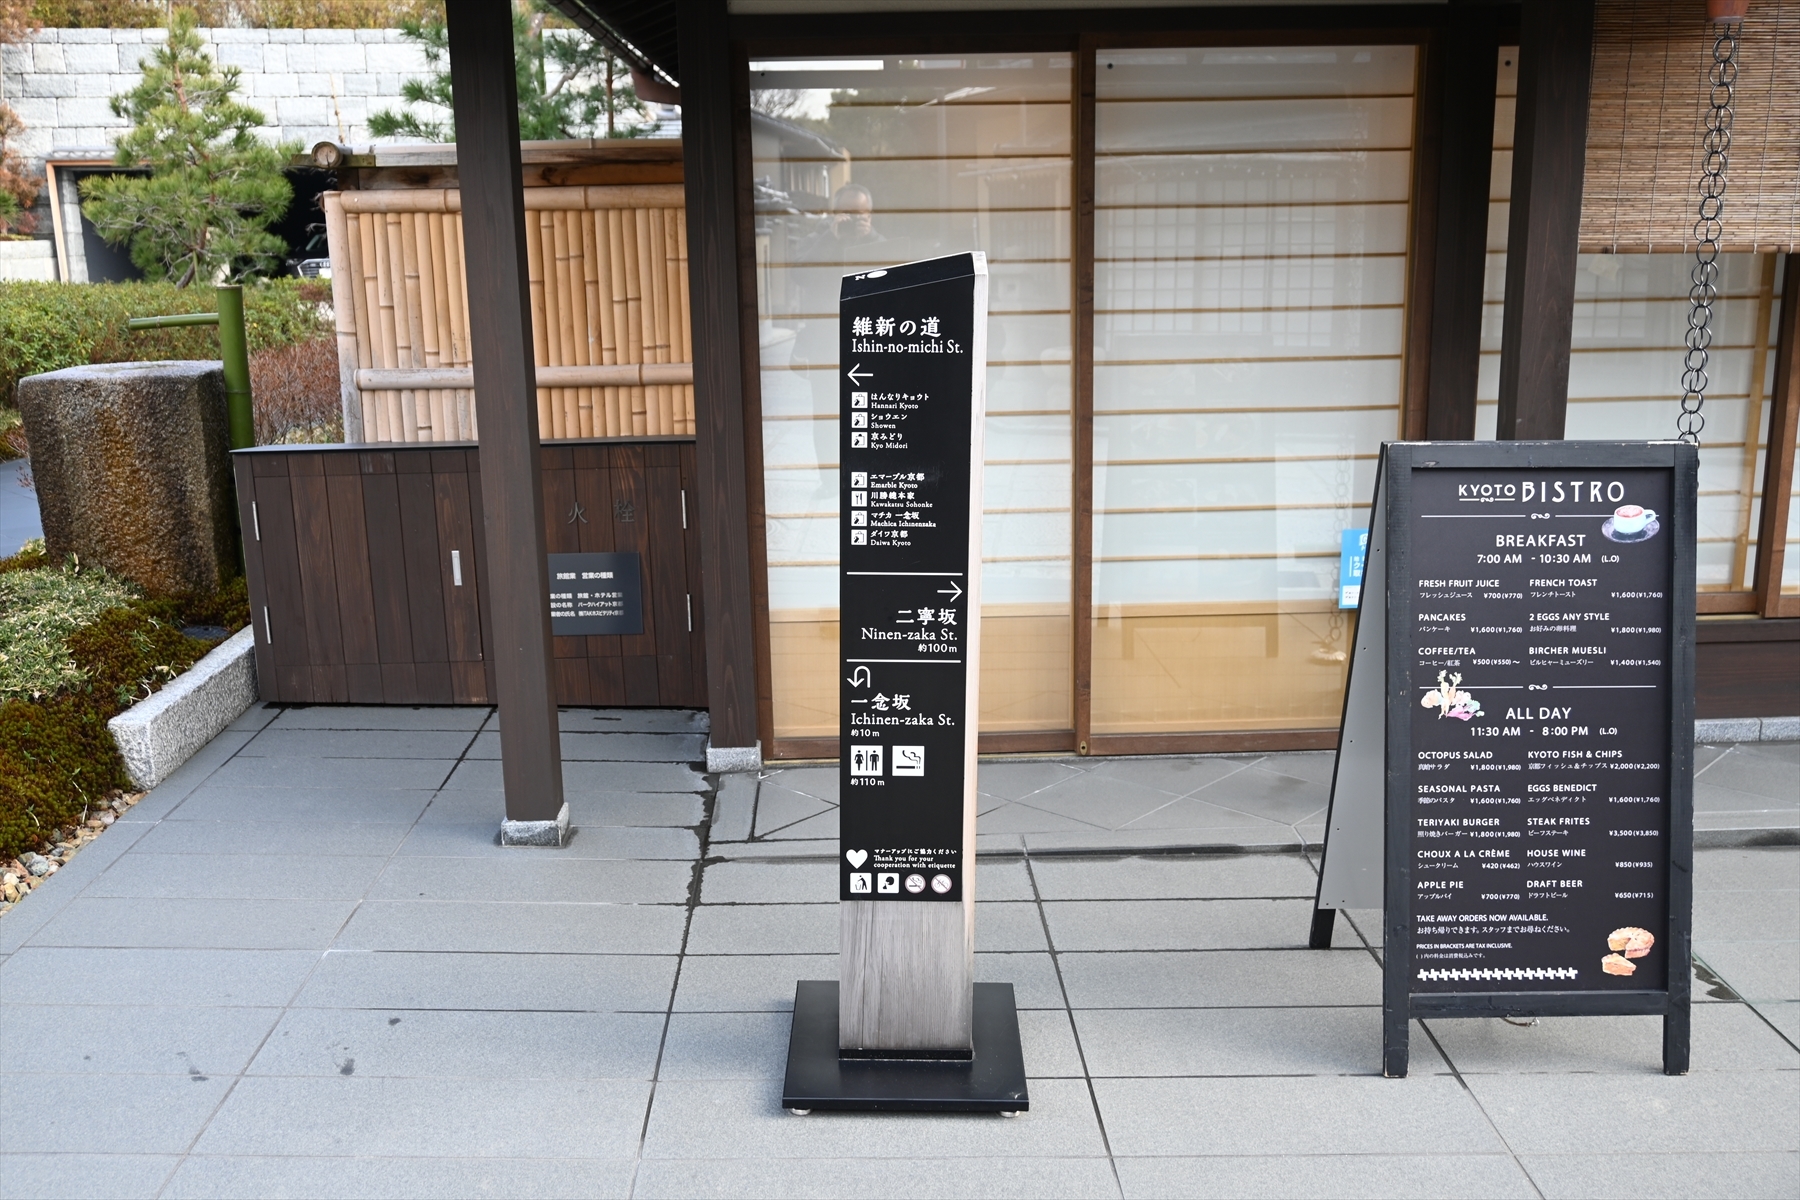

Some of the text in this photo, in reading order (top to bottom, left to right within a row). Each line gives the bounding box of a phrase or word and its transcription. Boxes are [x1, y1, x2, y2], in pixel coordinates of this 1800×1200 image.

[852, 316, 941, 337] 維新の道
[852, 338, 963, 353] Ishin-no-michi St.
[871, 393, 929, 401] はんなりキョウト
[871, 432, 902, 440] 京みどり
[871, 442, 883, 450] Kyo
[870, 472, 924, 481] エマーブル京都
[899, 482, 918, 490] Kyoto
[1458, 481, 1624, 502] KYOTO BISTRO
[871, 511, 919, 521] マチカ 一念坂
[871, 530, 908, 540] ダイワ京都
[1496, 534, 1586, 547] BREAKFAST
[1477, 554, 1500, 563] 7:00
[1504, 554, 1522, 563] AM
[1540, 554, 1569, 563] 10:30
[1573, 554, 1591, 563] AM
[896, 607, 957, 625] 二寧坂
[861, 628, 957, 640] Ninen-zaka St.
[1418, 647, 1475, 655] COFFEE/TEA
[851, 693, 911, 711] 一念坂
[1506, 707, 1571, 719] ALL DAY
[851, 713, 954, 725] Ichinen-zaka St.
[1471, 727, 1499, 736] 11:30
[1502, 727, 1520, 736] AM
[1542, 727, 1568, 736] 8:00
[1572, 726, 1588, 735] PM
[1464, 751, 1493, 759] SALAD
[1595, 750, 1622, 758] CHIPS
[1418, 785, 1467, 793] SEASONAL
[1528, 784, 1597, 792] EGGS BENEDICT
[1463, 818, 1499, 826] BURGER
[874, 848, 956, 856] マナーアップにご協力ください
[874, 853, 893, 861] Thank
[908, 853, 918, 861] for
[874, 861, 910, 869] cooperation
[1527, 880, 1557, 888] DRAFT
